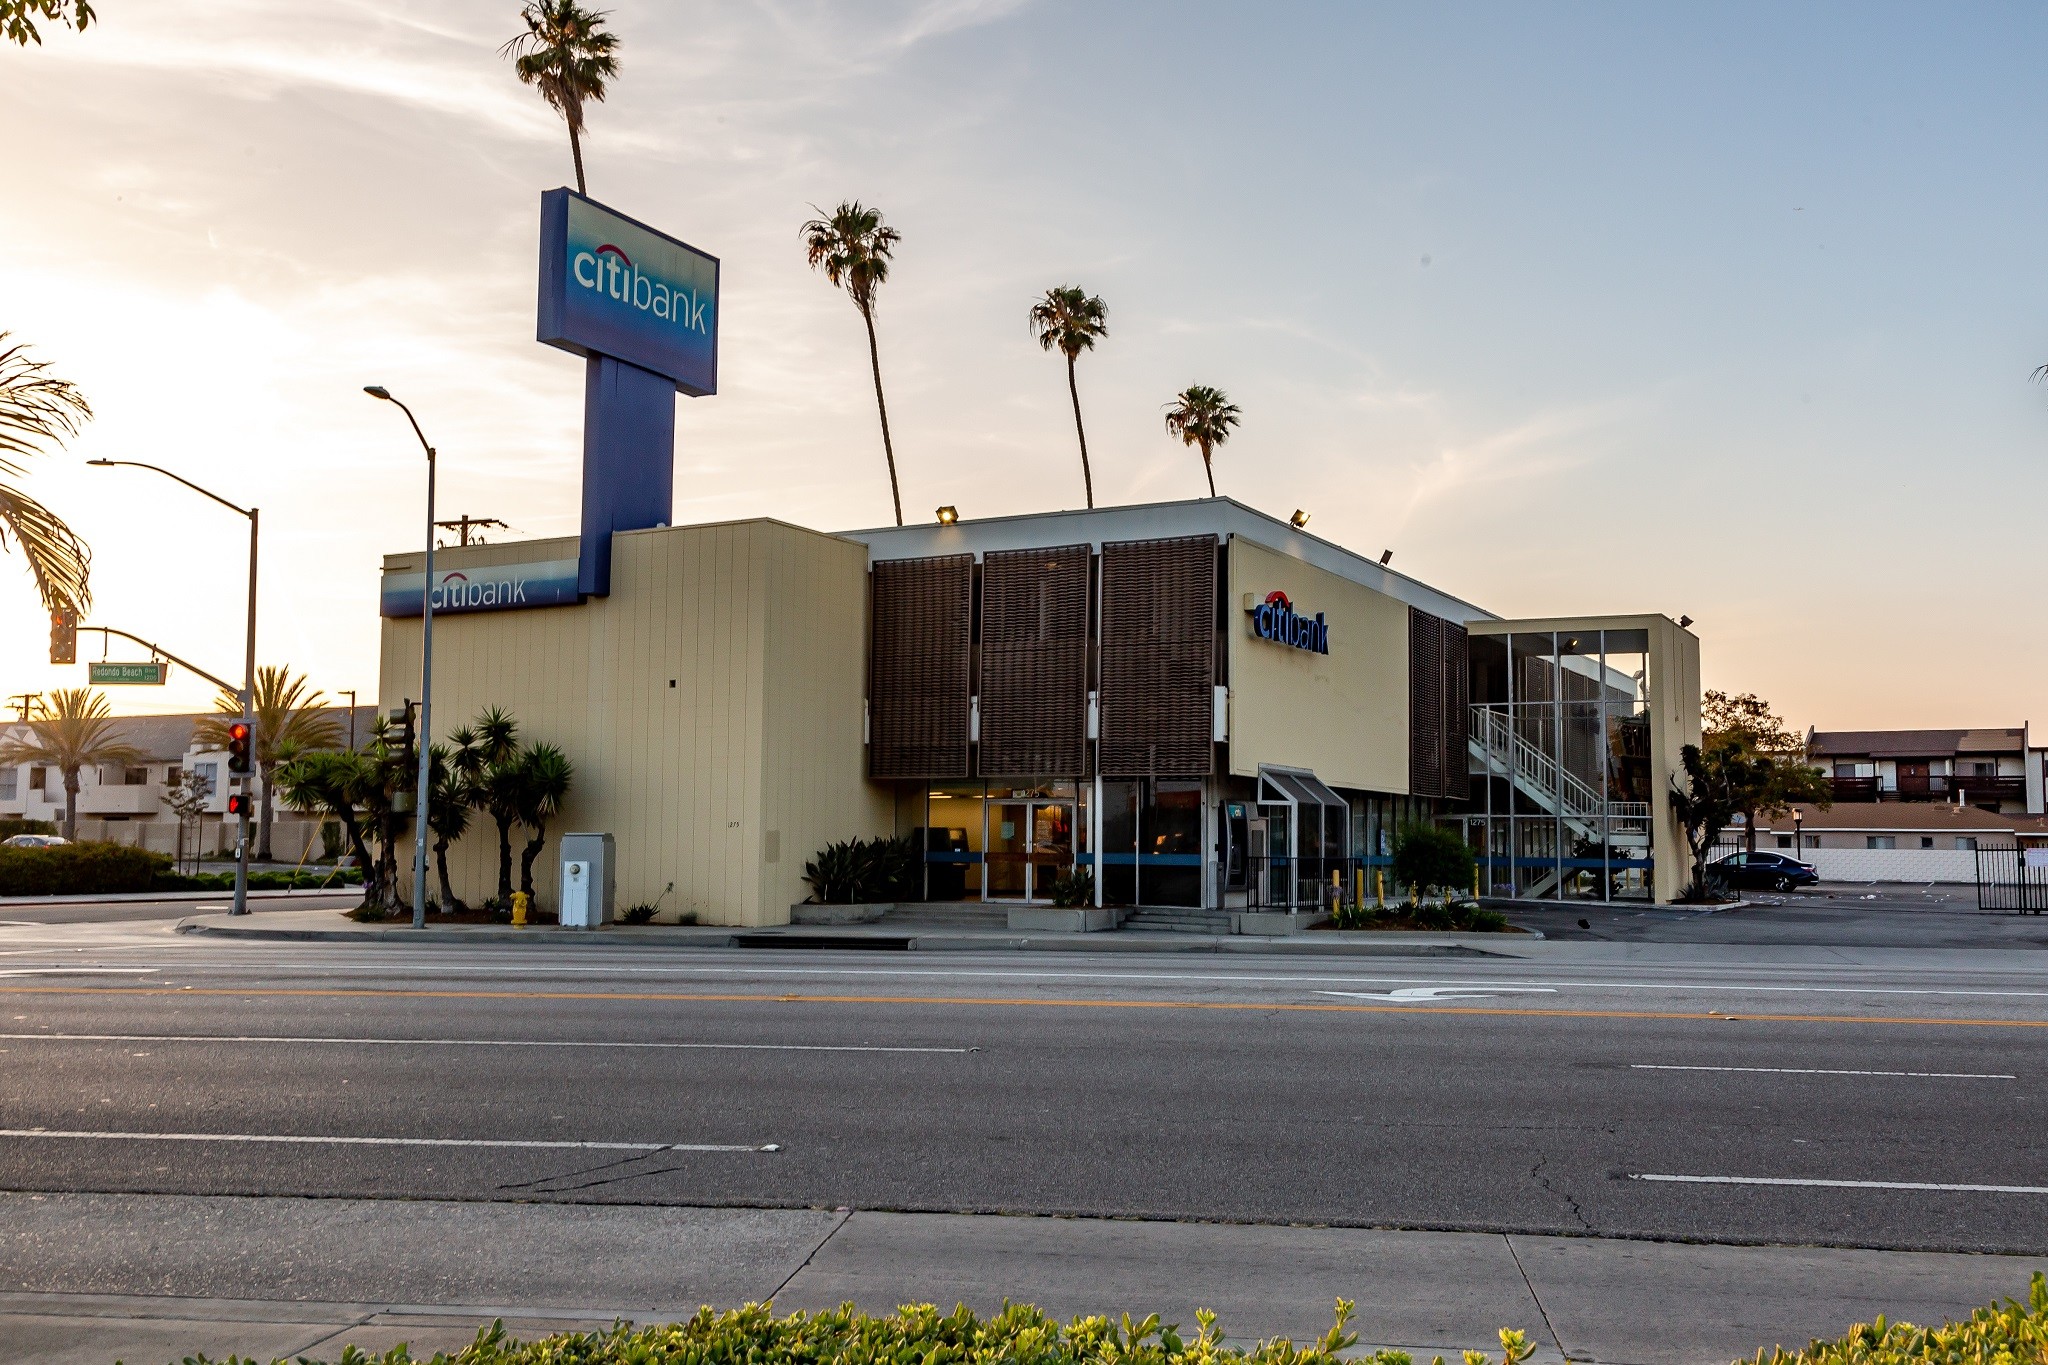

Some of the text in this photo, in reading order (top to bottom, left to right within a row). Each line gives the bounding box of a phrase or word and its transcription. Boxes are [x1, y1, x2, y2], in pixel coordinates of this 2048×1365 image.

[573, 251, 706, 335] citibank
[431, 574, 526, 609] citibank
[1254, 600, 1329, 655] citibank
[92, 666, 120, 677] Redondo
[122, 666, 143, 677] Beach
[1470, 818, 1486, 826] 1275
